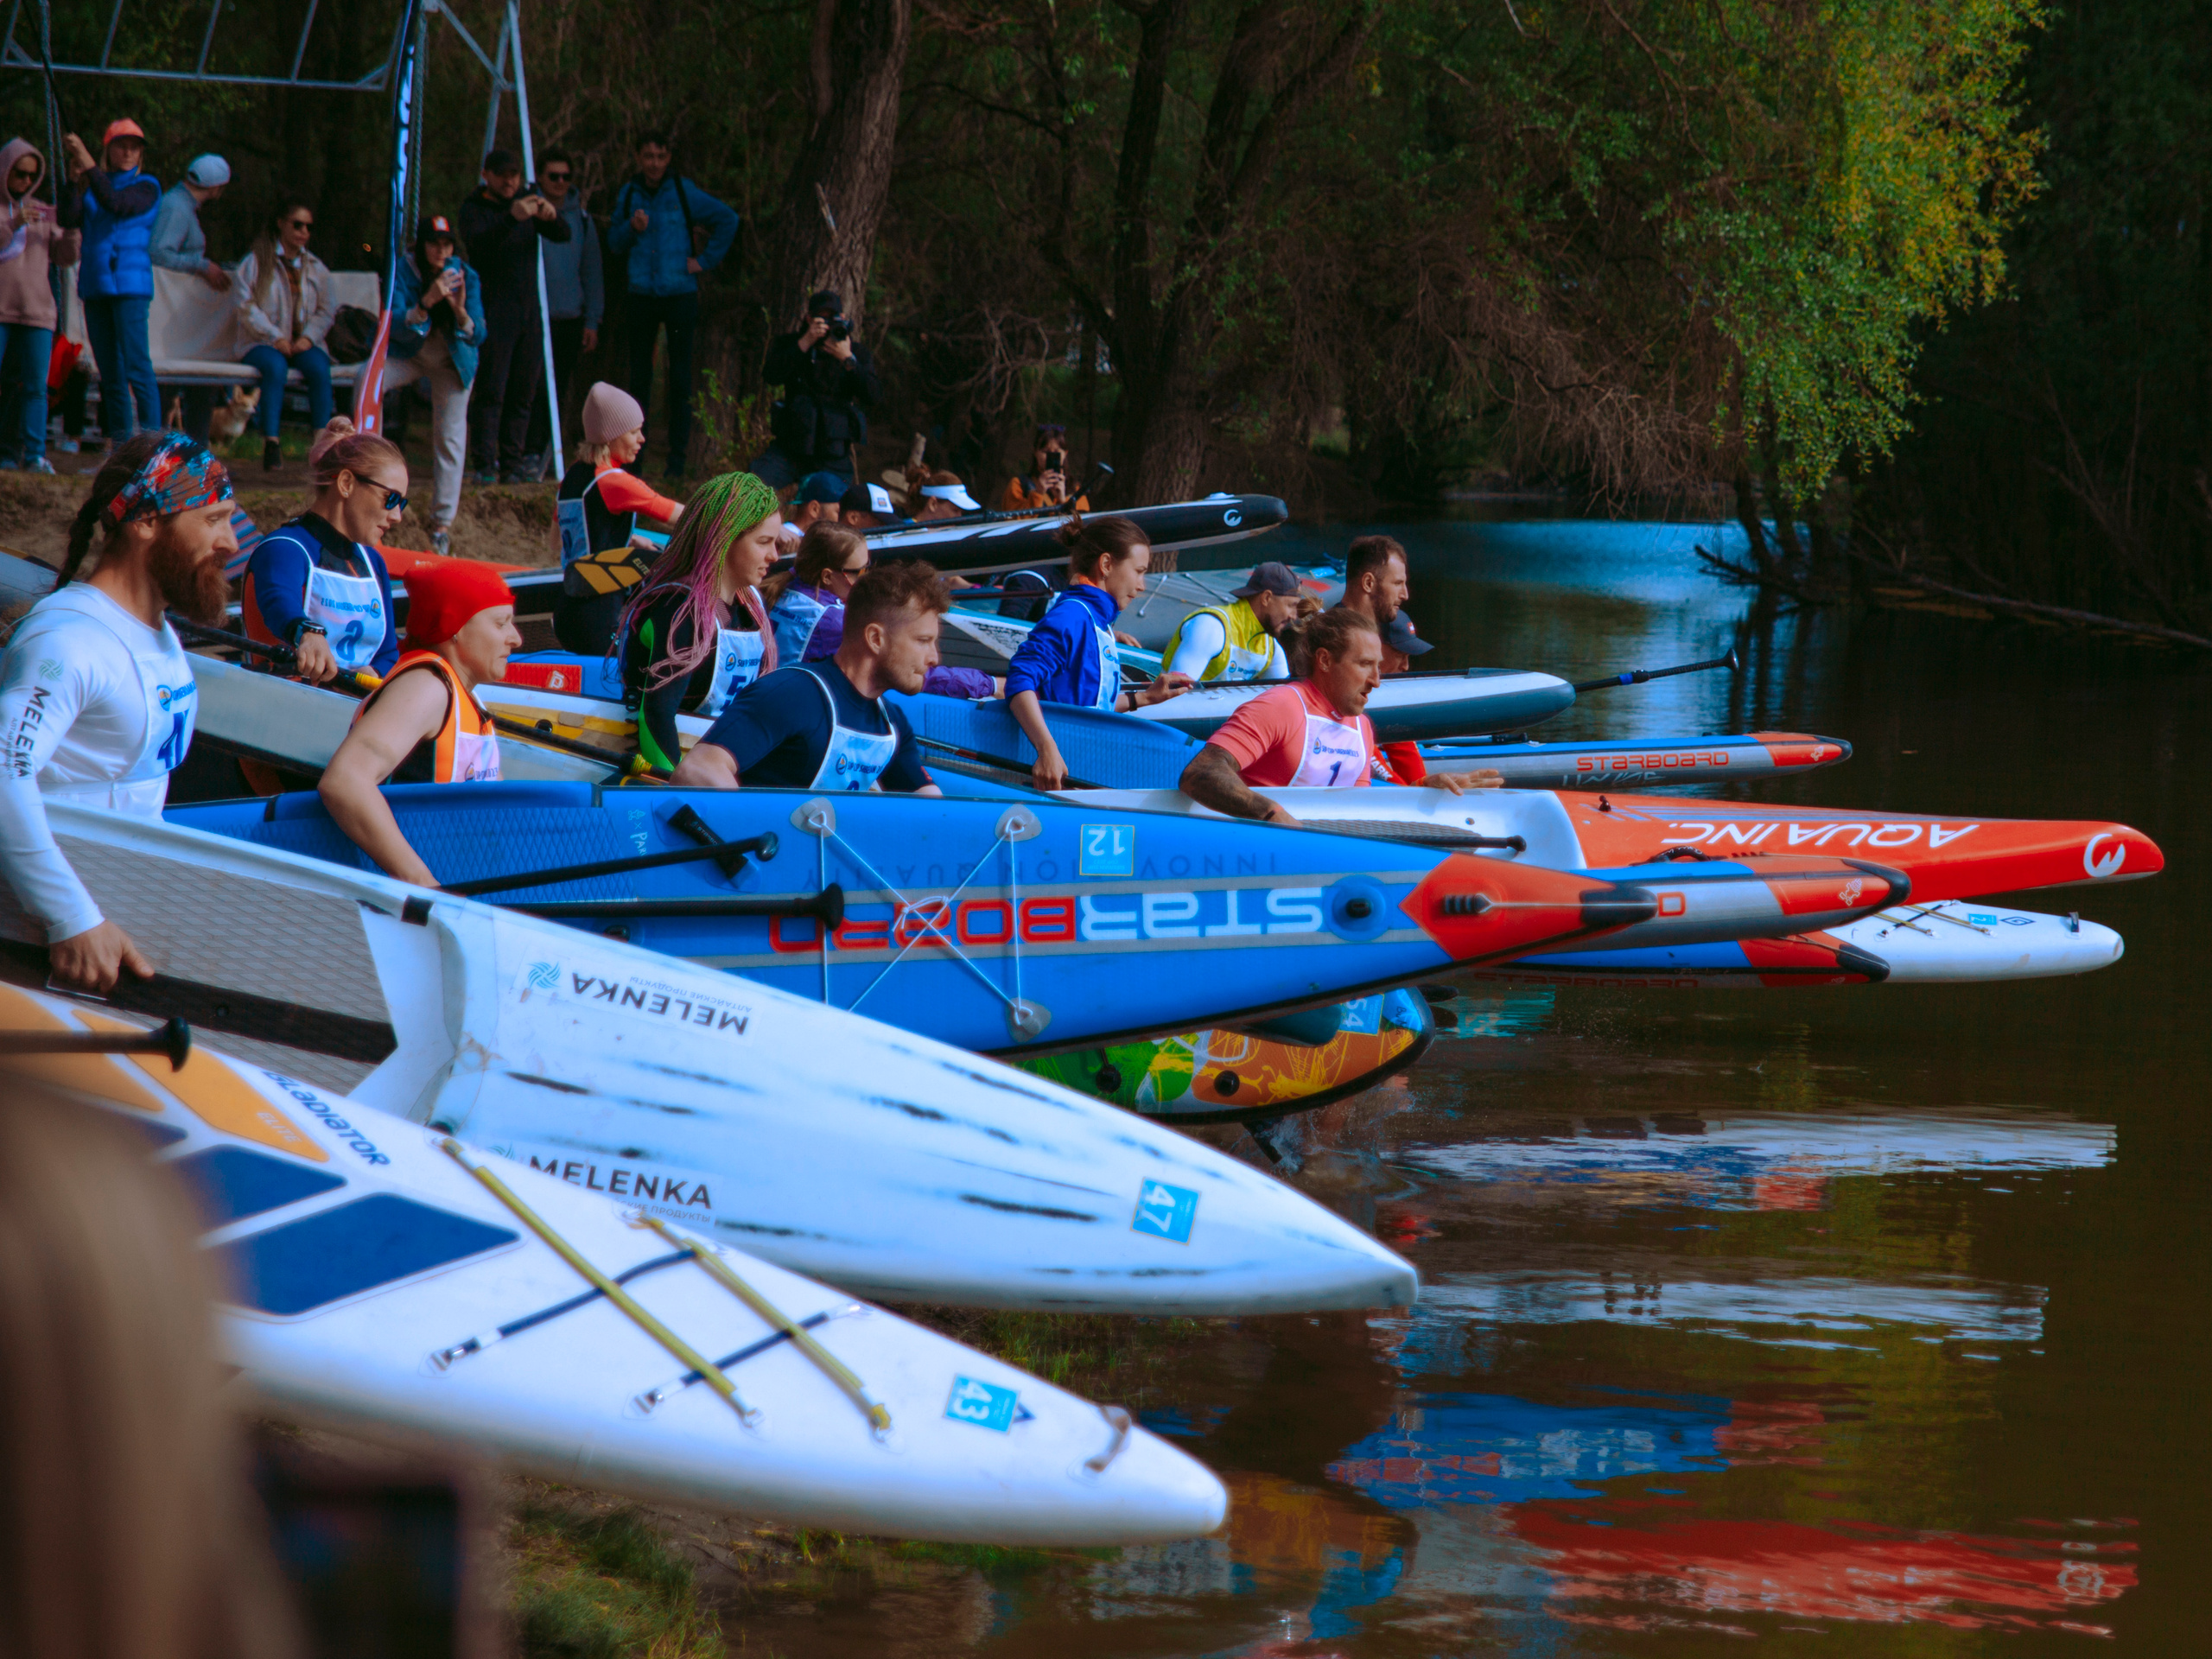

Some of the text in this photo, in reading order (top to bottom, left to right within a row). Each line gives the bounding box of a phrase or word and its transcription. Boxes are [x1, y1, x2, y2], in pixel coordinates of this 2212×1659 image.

[1329, 761, 1342, 786] 1
[1577, 752, 1729, 772] STARBOARD
[1088, 830, 1126, 857] 12
[1000, 852, 1275, 883] INNOVION
[769, 887, 1324, 953] STARBOARD
[572, 972, 749, 1036] MELENKA
[629, 976, 753, 1013] АЛТАЙСКИЕ ПРОДУКТЫ
[1342, 998, 1368, 1027] 54
[257, 1111, 302, 1143] ELITE
[262, 1071, 391, 1166] GLADIATOR
[530, 1155, 712, 1210] MELENKA
[650, 1205, 711, 1224] ПРОДУКТЫ
[1141, 1185, 1176, 1233] 47
[953, 1382, 993, 1421] 43
